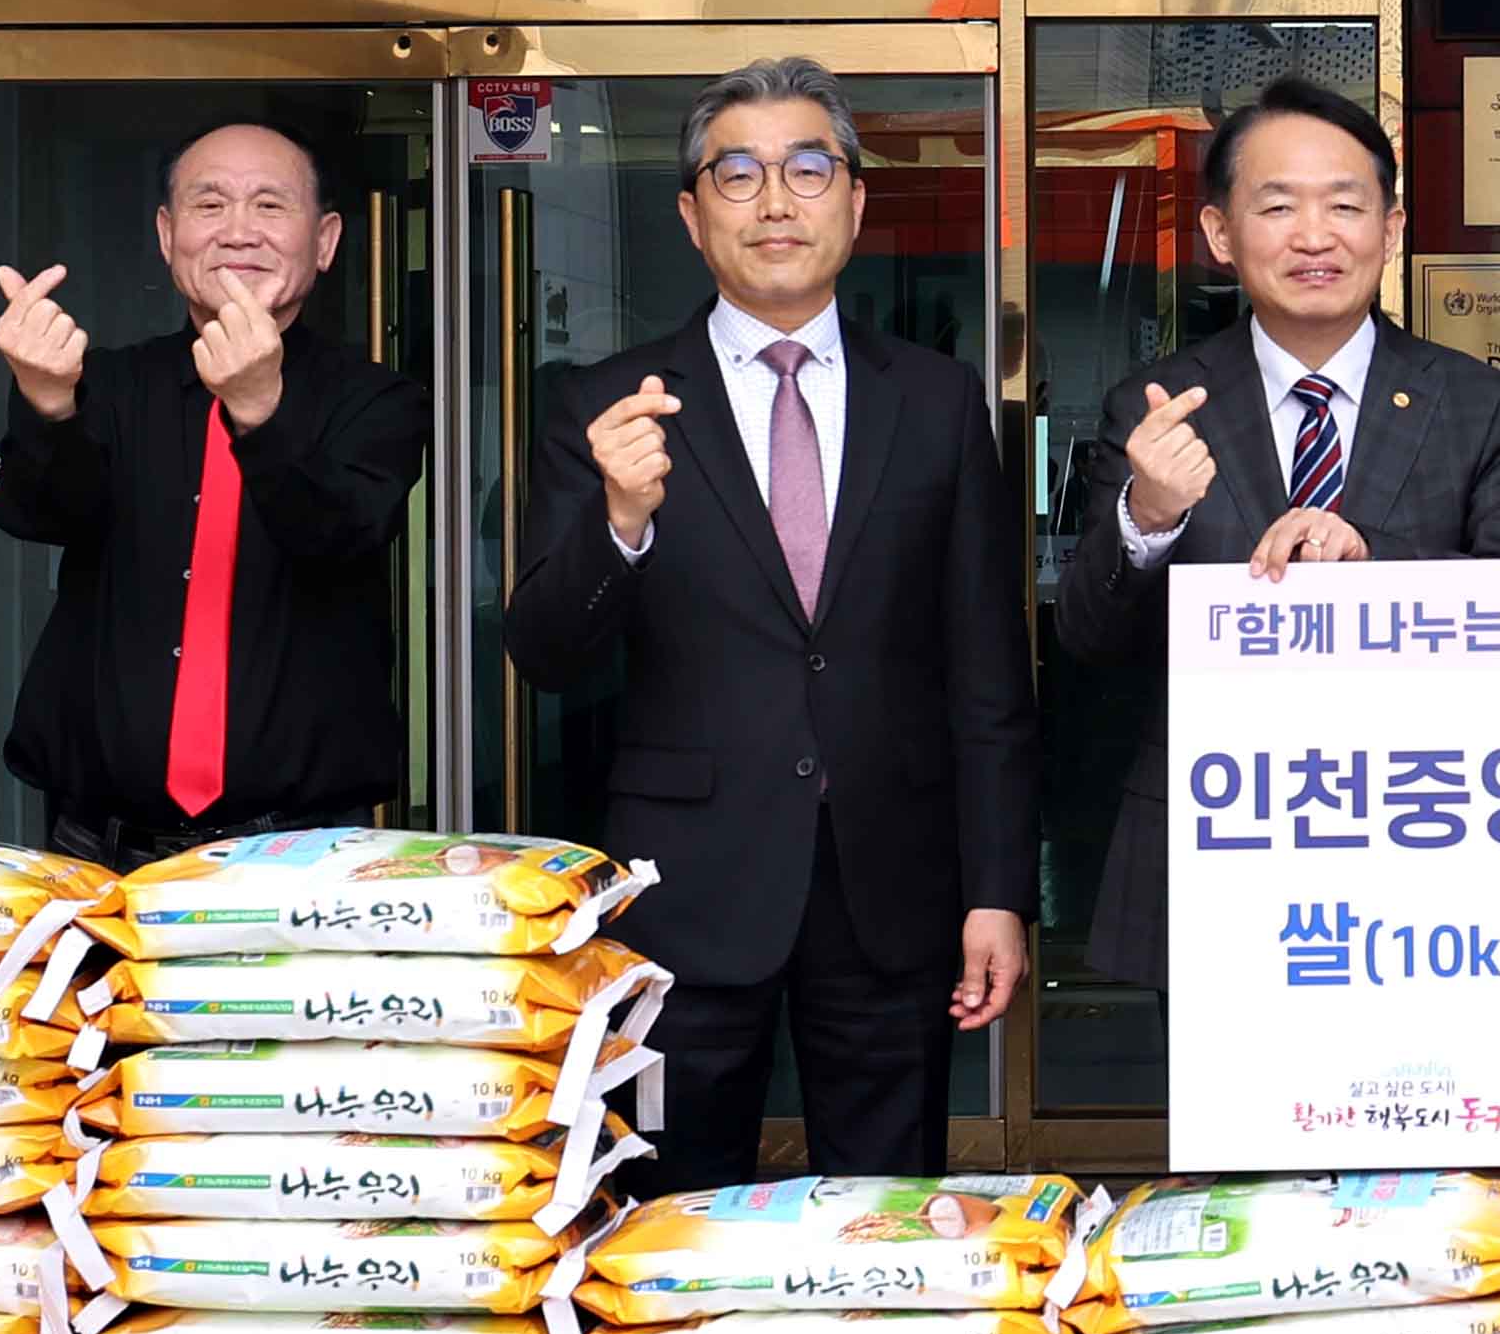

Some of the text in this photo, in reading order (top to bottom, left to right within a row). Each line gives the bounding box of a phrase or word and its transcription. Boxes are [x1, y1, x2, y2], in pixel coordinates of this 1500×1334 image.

[477, 82, 508, 93] CCTV
[490, 116, 532, 132] BOSS
[1364, 1103, 1451, 1132] 행복도시
